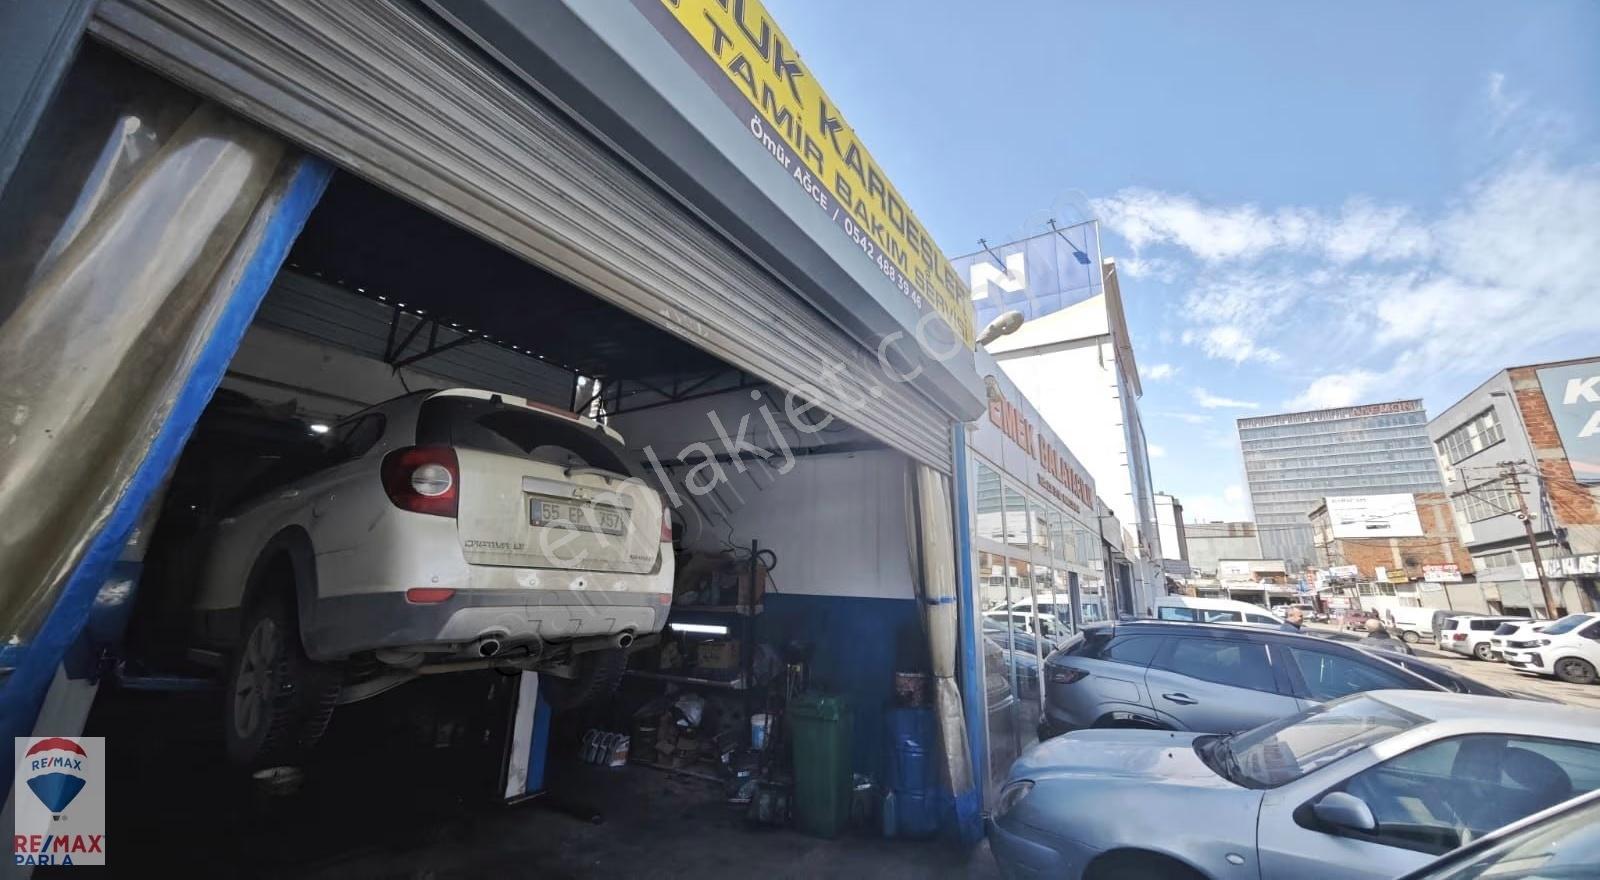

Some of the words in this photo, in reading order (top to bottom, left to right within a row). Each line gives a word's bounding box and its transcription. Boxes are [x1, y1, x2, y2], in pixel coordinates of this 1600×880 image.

[703, 8, 824, 176] TAMİR
[835, 169, 908, 274] BAKIM
[717, 0, 804, 109] UK
[750, 115, 791, 169] Ömür
[792, 166, 828, 211] AĞCE
[843, 217, 876, 261] 0542
[876, 254, 896, 284] 488
[897, 273, 910, 298] 39
